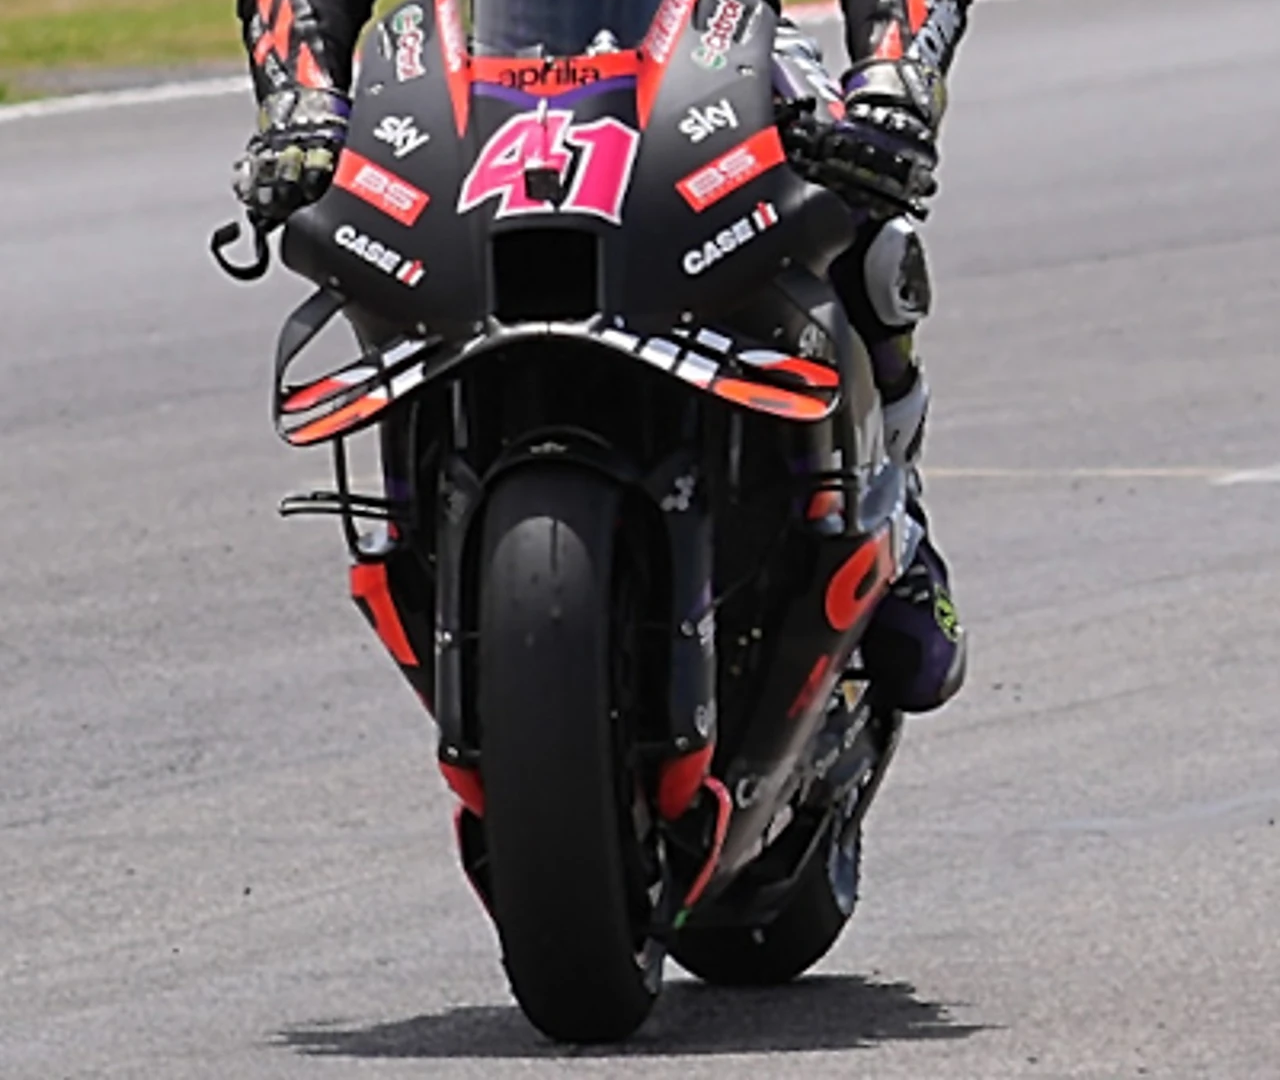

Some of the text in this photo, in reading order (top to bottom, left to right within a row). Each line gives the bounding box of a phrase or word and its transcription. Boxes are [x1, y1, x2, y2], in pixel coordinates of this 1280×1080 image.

[373, 116, 430, 157] sky
[679, 99, 738, 142] sky
[456, 108, 641, 226] 41
[335, 224, 402, 274] CASE
[683, 218, 755, 274] CASE
